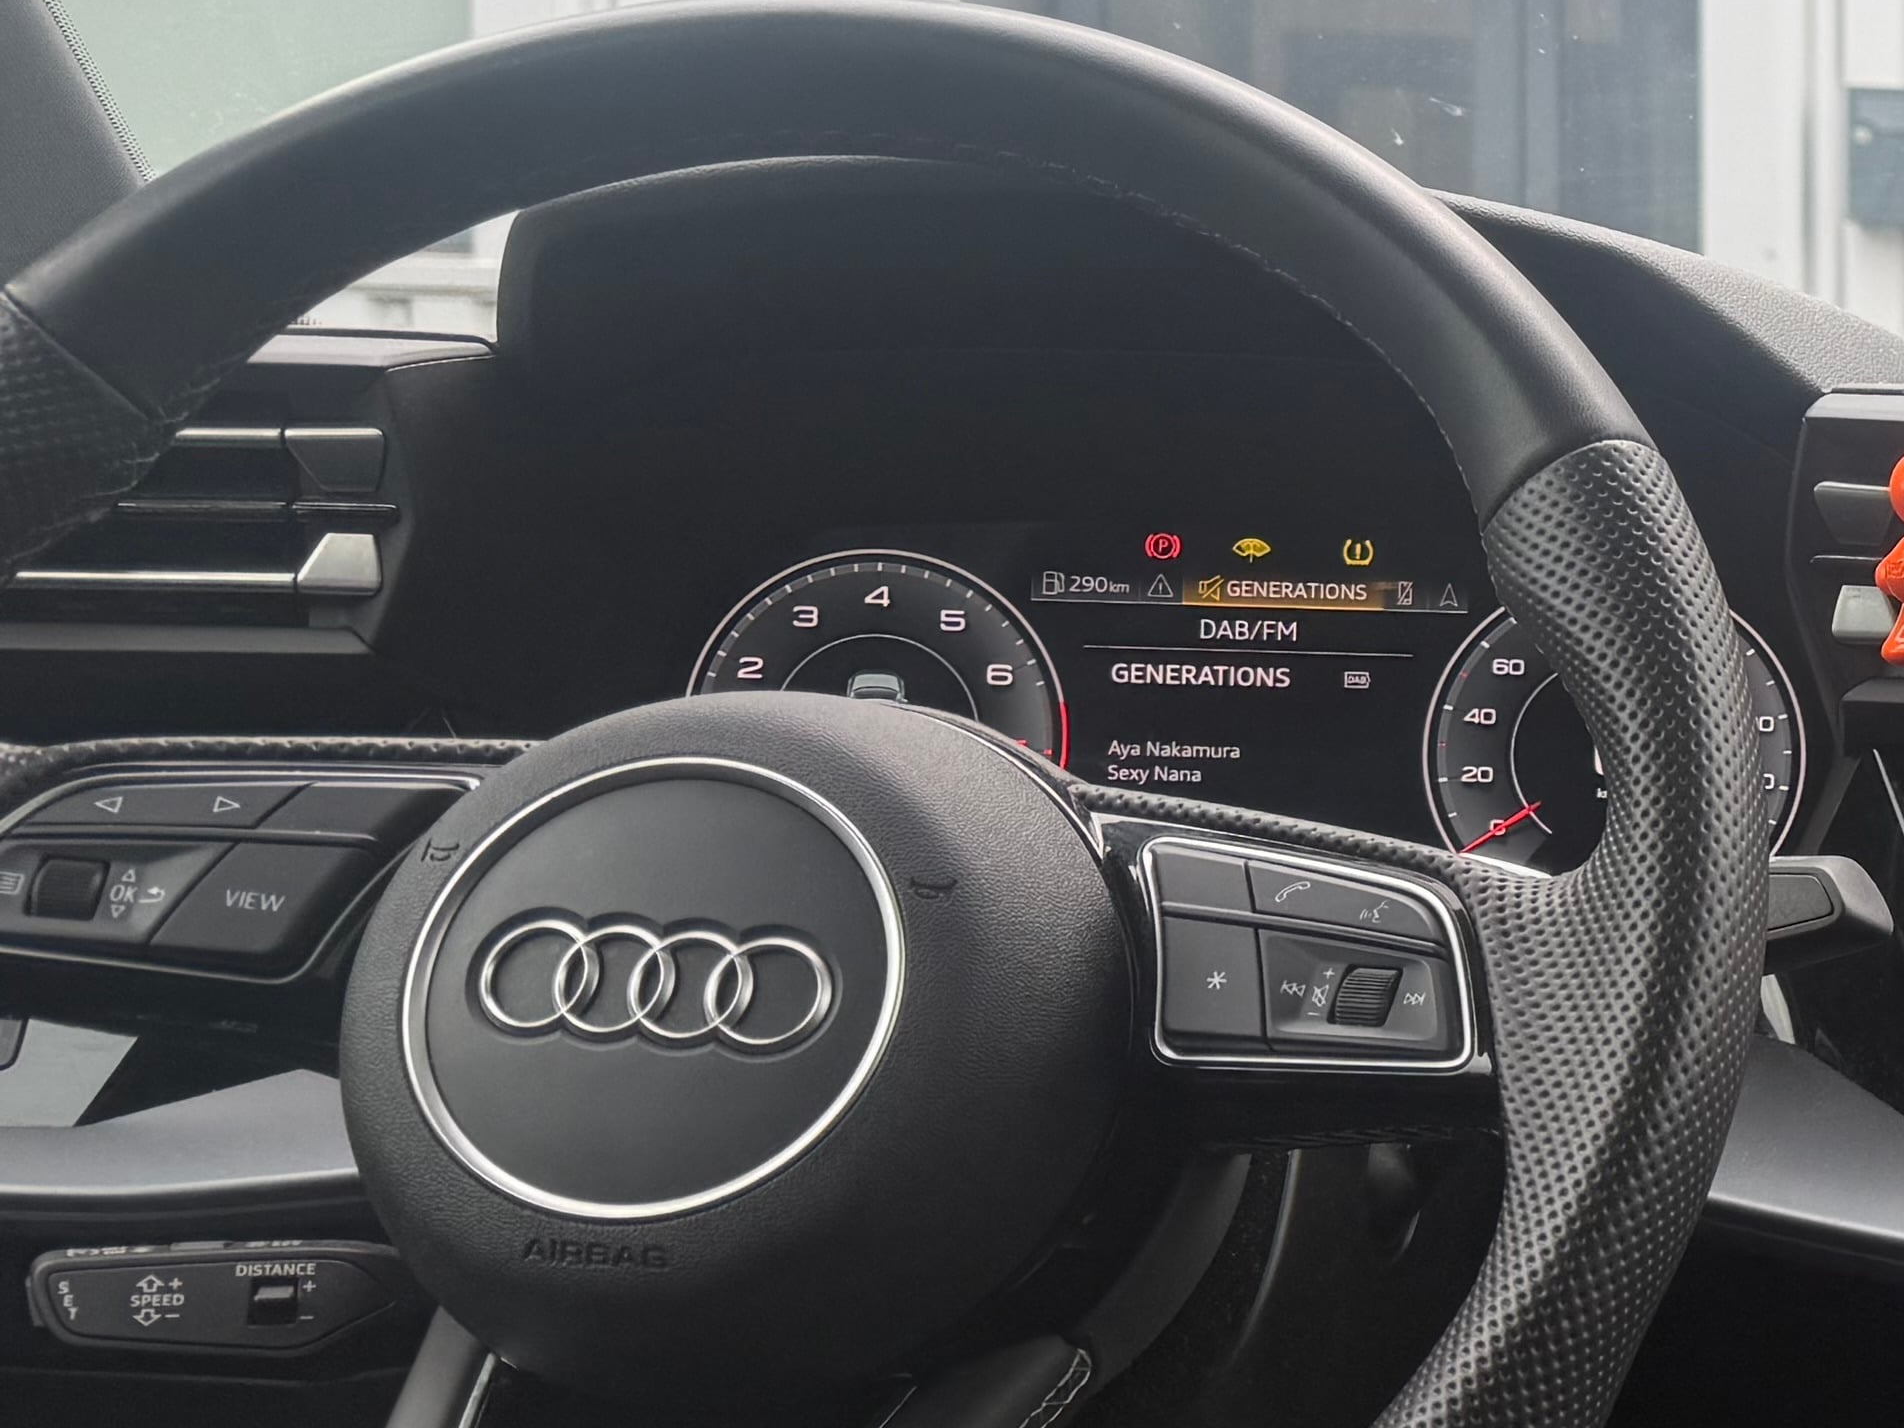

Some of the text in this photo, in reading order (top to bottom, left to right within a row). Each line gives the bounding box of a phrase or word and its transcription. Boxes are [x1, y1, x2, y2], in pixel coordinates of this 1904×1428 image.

[863, 585, 891, 608] 4
[1226, 579, 1368, 601] GENERATIONS
[792, 605, 819, 628] 3
[939, 609, 966, 632] 5
[1200, 618, 1298, 642] DAB/FM
[737, 656, 764, 680] 2
[986, 663, 1014, 687] 6
[1111, 663, 1291, 688] GENERATIONS
[1492, 659, 1525, 676] 60
[1463, 708, 1497, 725] 40
[1108, 740, 1241, 761] Aya Nakamura
[1107, 765, 1202, 786] Sexy Nana
[1461, 766, 1493, 783] 20
[109, 884, 137, 905] OK
[224, 888, 285, 913] VIEW
[523, 1238, 669, 1269] AIRBAG
[235, 1262, 316, 1277] DISTANCE
[130, 1294, 184, 1308] SPEED
